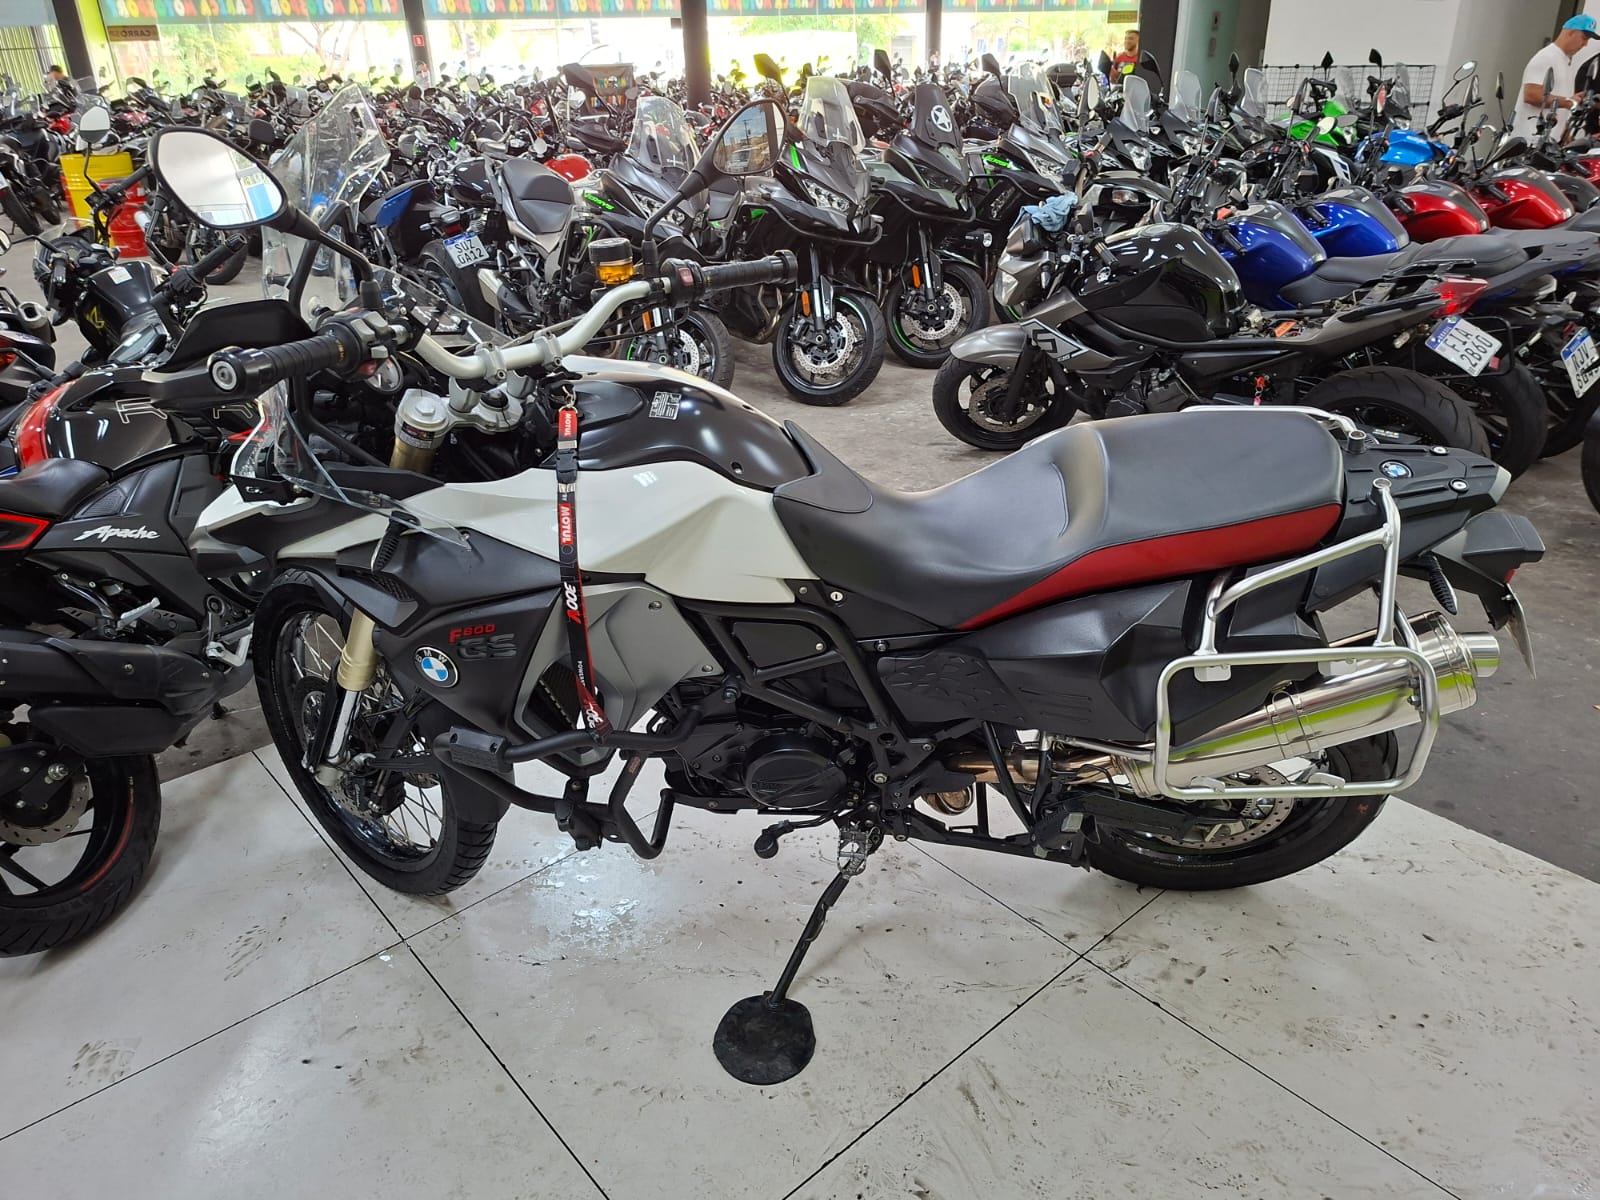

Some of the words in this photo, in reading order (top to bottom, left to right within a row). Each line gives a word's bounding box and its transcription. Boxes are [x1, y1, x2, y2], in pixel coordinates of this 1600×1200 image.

[455, 239, 475, 253] SUZ
[457, 247, 484, 264] GA12
[1443, 327, 1473, 353] FIA
[1460, 334, 1493, 368] 2B60
[1571, 343, 1589, 370] RJV
[564, 413, 572, 437] MOTUL
[73, 525, 160, 543] Apache
[561, 505, 571, 543] MOTUL
[564, 581, 582, 624] 300V
[448, 623, 496, 644] F800
[415, 649, 448, 663] BMW
[458, 633, 517, 660] GS
